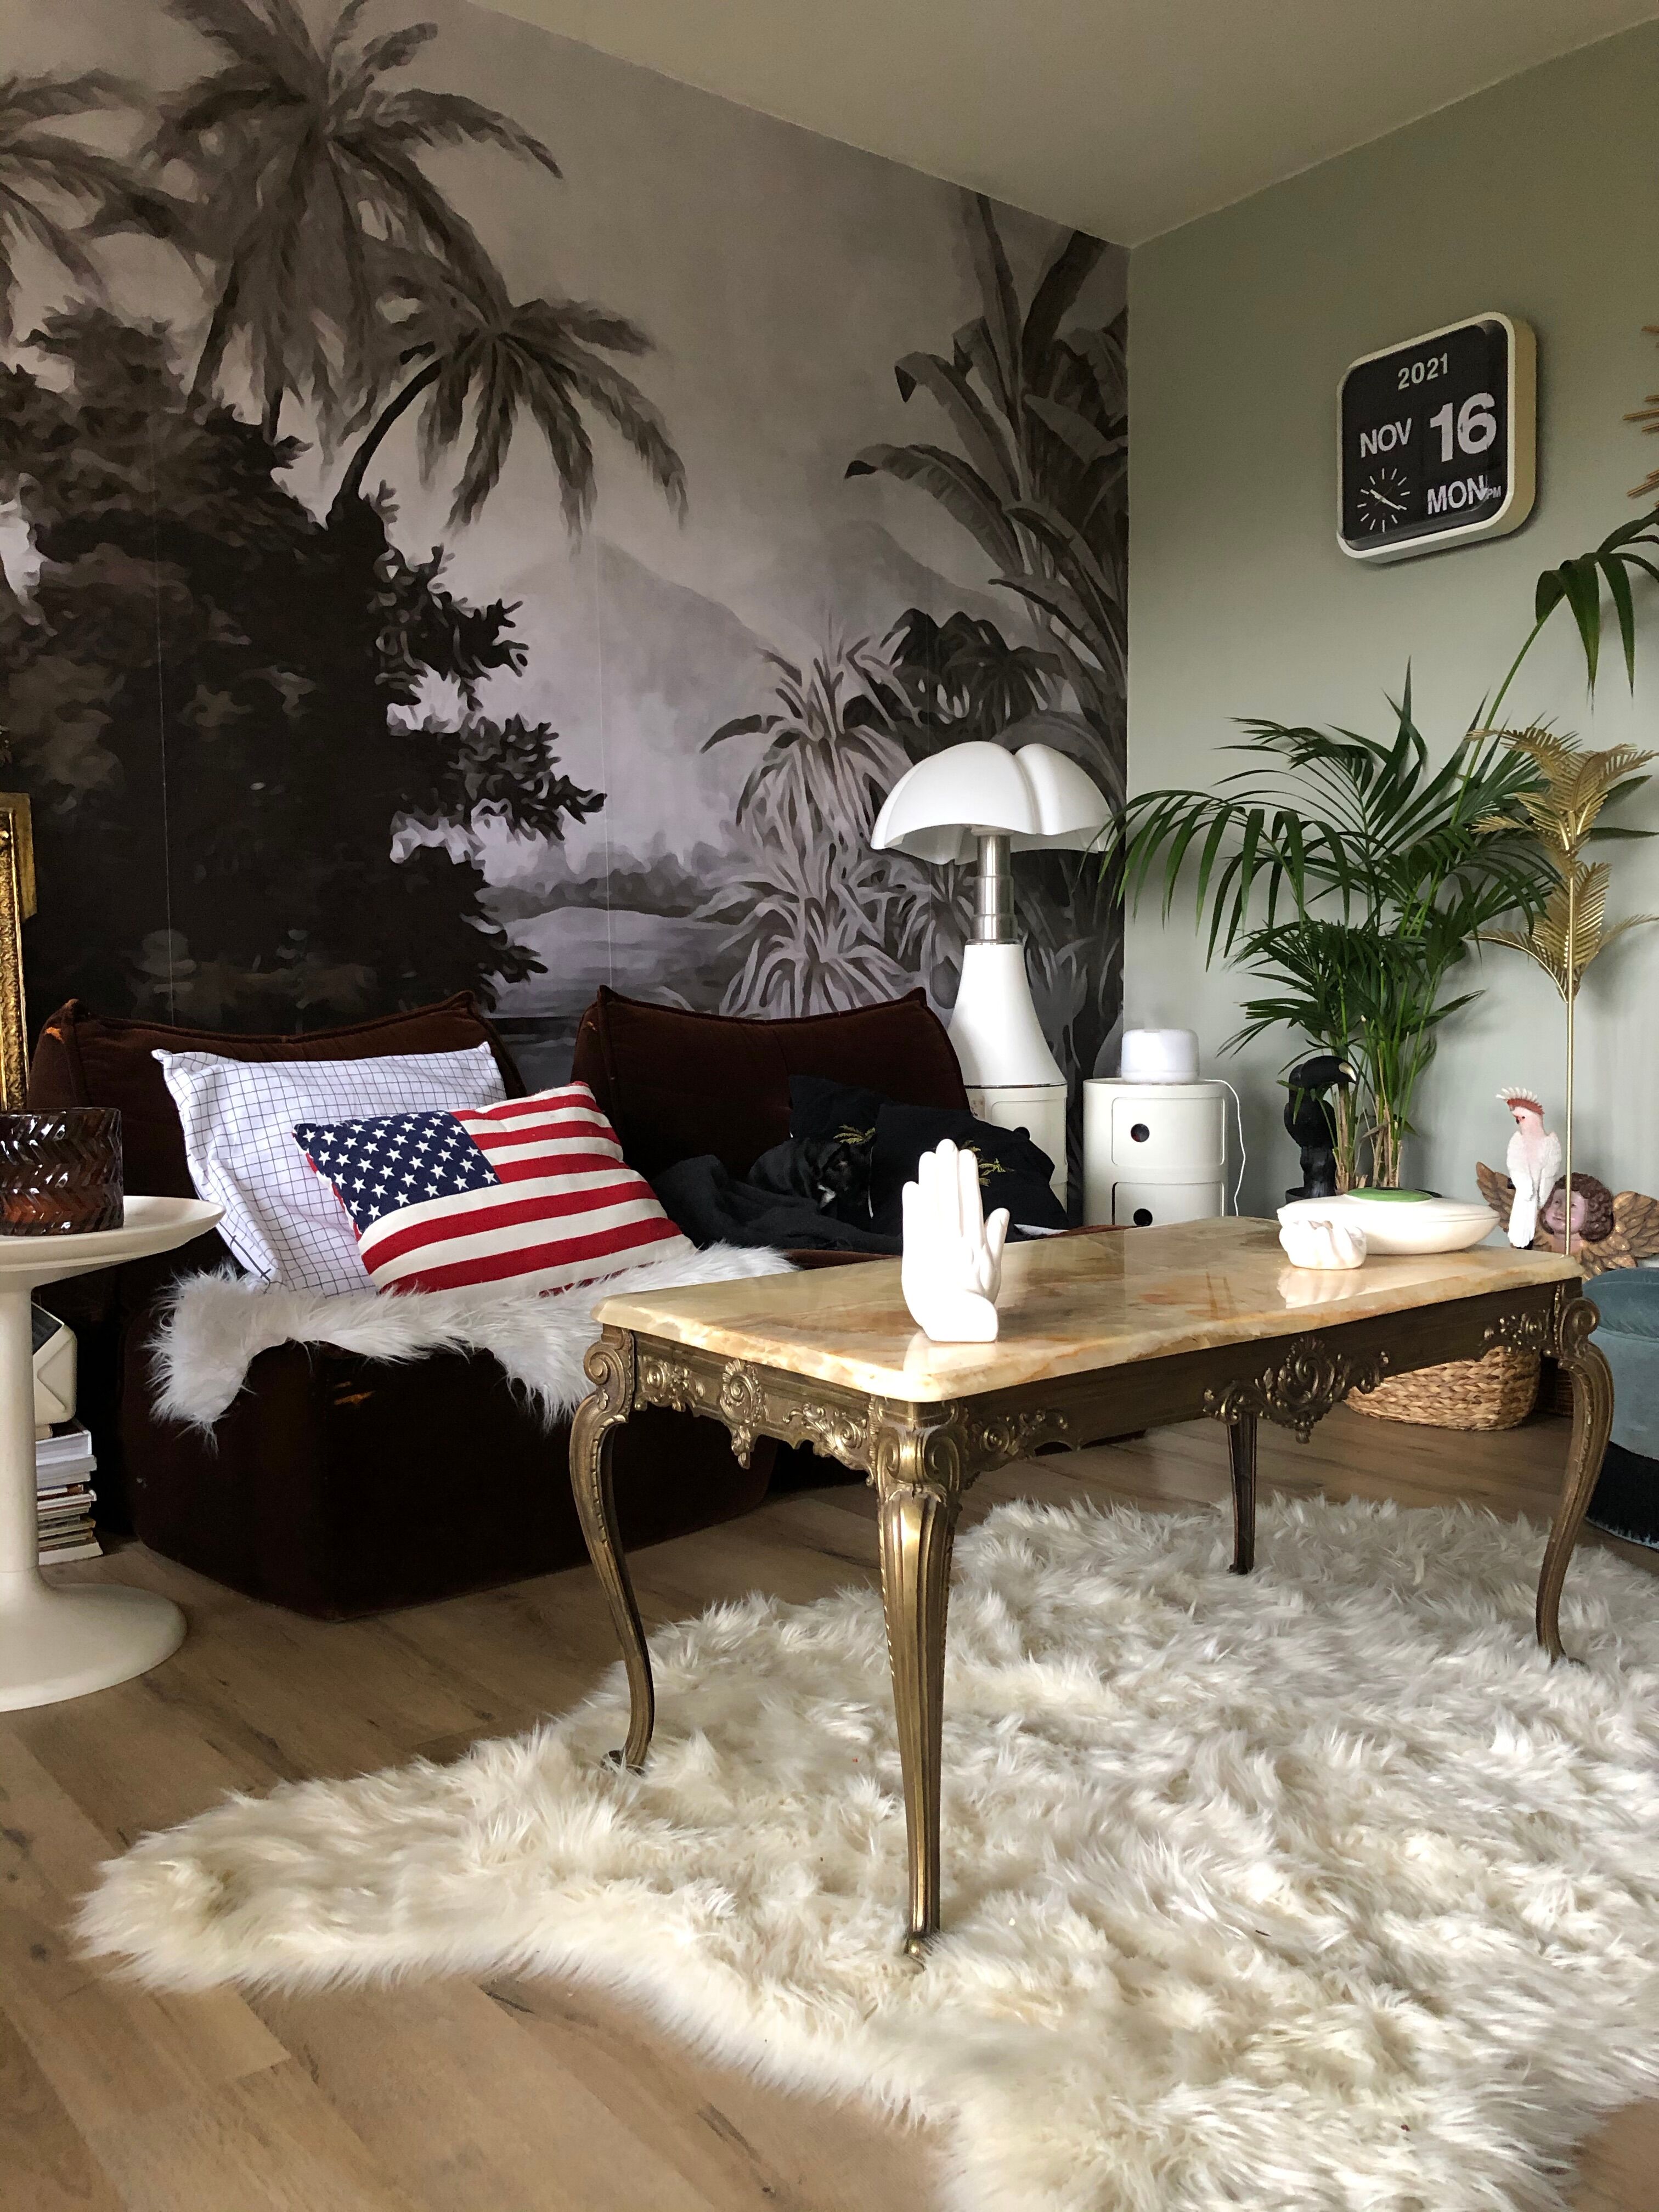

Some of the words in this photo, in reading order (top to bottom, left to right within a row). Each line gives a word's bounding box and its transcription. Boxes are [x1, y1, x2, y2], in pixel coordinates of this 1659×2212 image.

[1398, 353, 1448, 390] 2021
[1360, 417, 1412, 458] NOV
[1430, 392, 1497, 462] 16
[1427, 475, 1487, 515] MON
